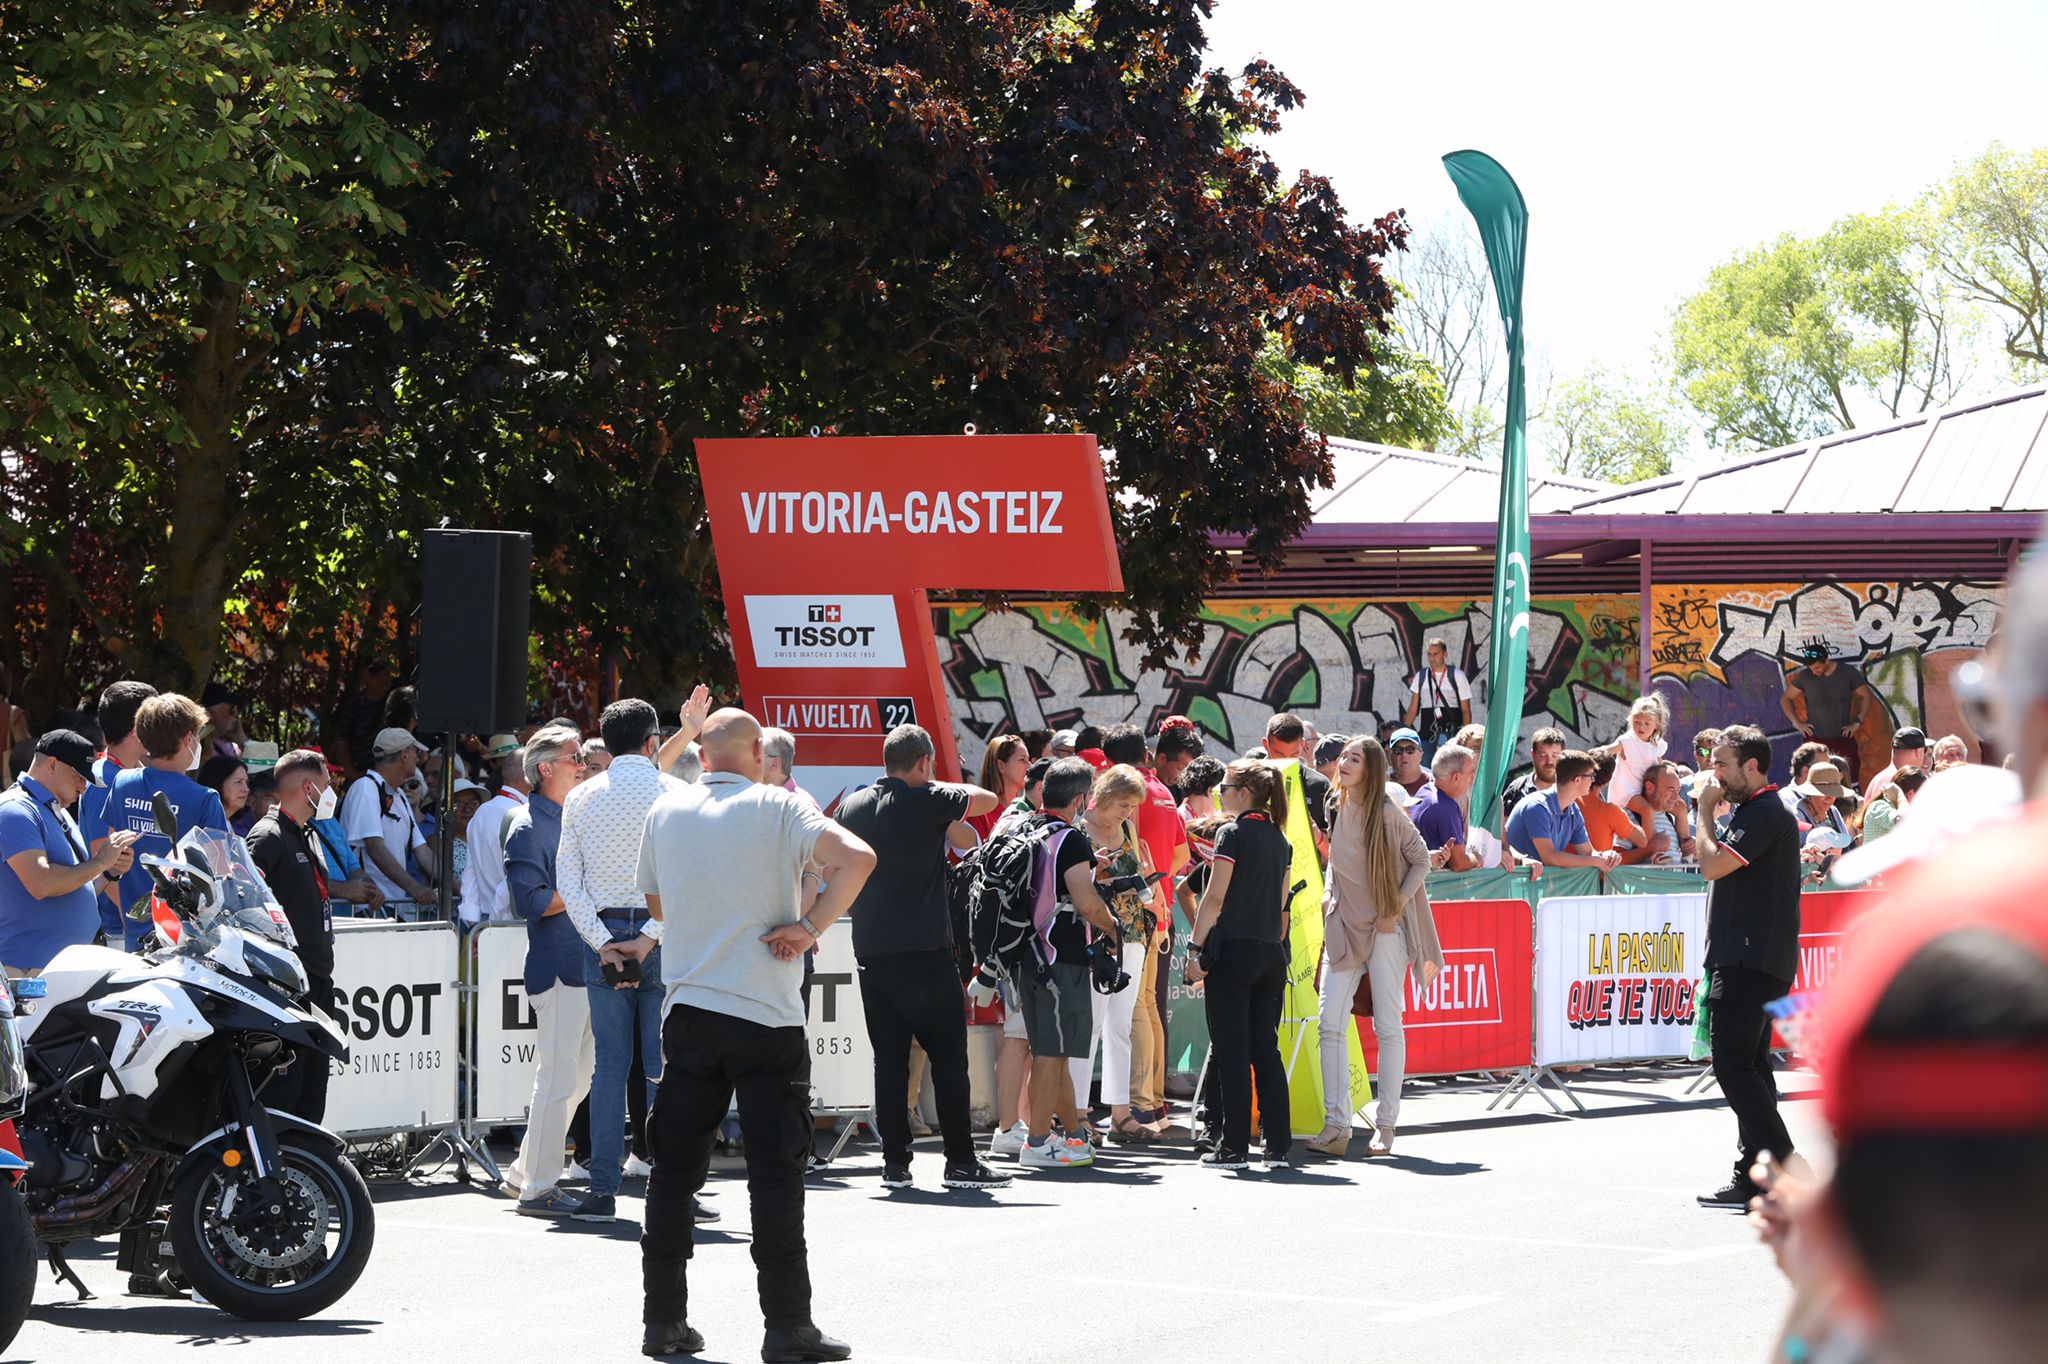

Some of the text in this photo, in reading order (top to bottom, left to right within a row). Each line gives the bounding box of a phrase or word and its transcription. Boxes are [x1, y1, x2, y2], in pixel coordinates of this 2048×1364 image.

[741, 491, 1063, 534] VITORIA-GASTEIZ
[774, 626, 875, 647] TISSOT
[776, 704, 910, 729] LA VUELTA 22
[1589, 922, 1685, 975] LA PASIÓN
[1566, 979, 1616, 1031] QUE
[1618, 977, 1648, 1026] TE
[816, 1036, 853, 1055] 853
[354, 1052, 400, 1075] SINCE
[409, 1049, 441, 1071] 1853
